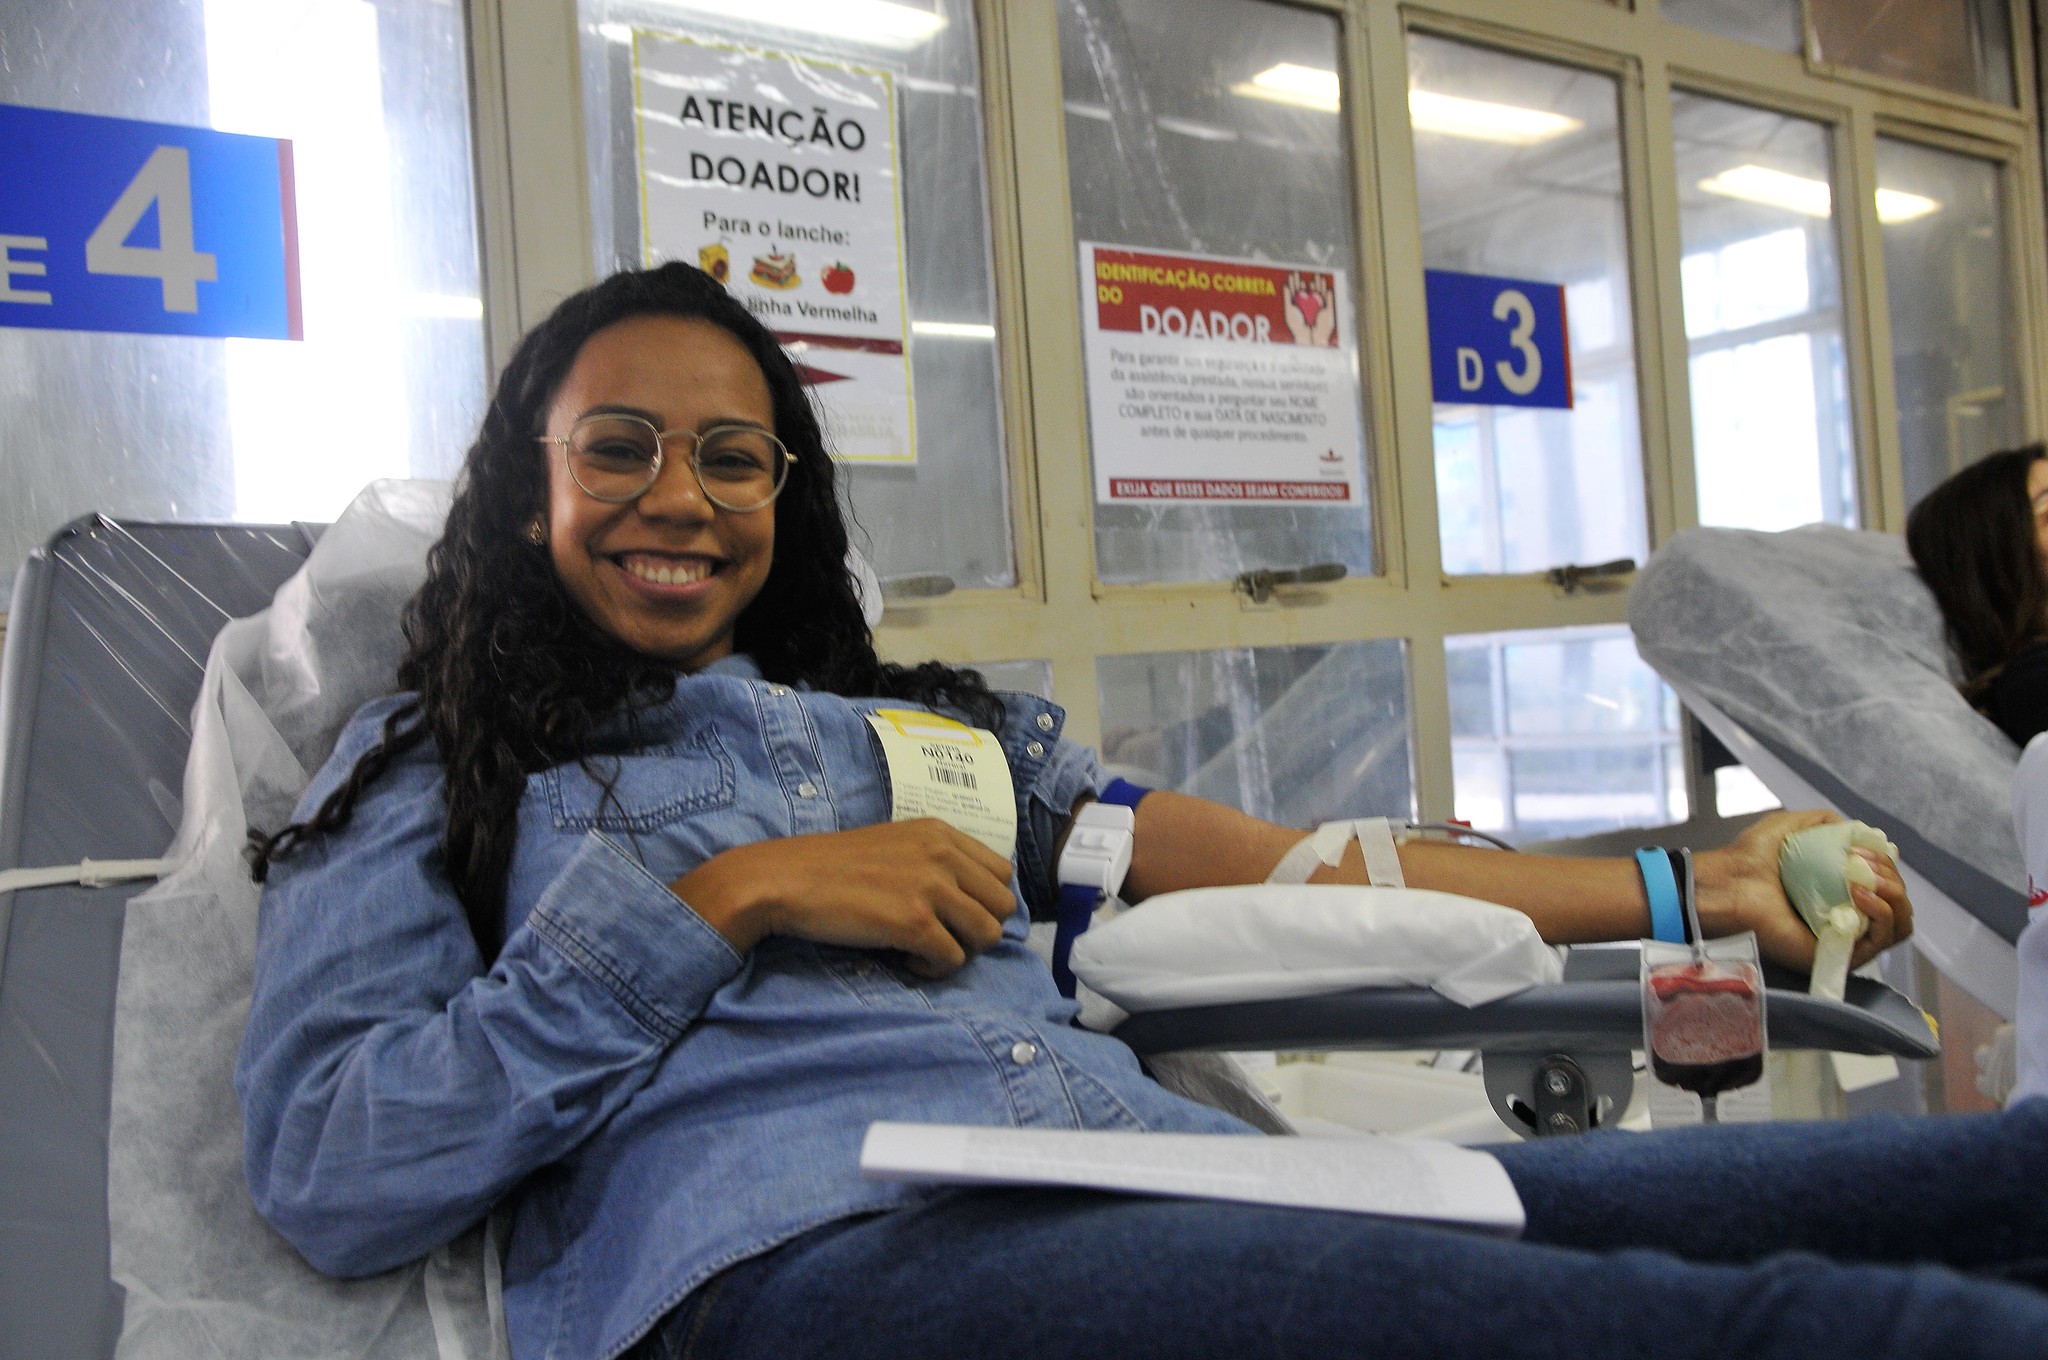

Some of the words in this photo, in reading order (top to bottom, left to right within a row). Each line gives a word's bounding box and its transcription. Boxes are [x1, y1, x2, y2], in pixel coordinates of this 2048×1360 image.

[680, 95, 866, 151] ATENÇÃO
[690, 152, 860, 203] DOADOR!
[85, 144, 218, 314] 4
[703, 210, 751, 235] Para
[758, 221, 771, 236] o
[778, 217, 850, 246] lanche:
[1096, 262, 1211, 291] IDENTIFICAÇÃO
[1212, 273, 1277, 297] CORRETA
[1098, 284, 1124, 305] DO
[796, 301, 878, 324] Vermelha
[1140, 304, 1272, 344] DOADOR
[1456, 346, 1484, 391] D
[1491, 288, 1542, 396] 3
[1118, 403, 1182, 420] COMPLETO
[1214, 406, 1242, 423] DATA
[1243, 408, 1258, 424] DE
[1260, 409, 1328, 428] NASCIMENTO
